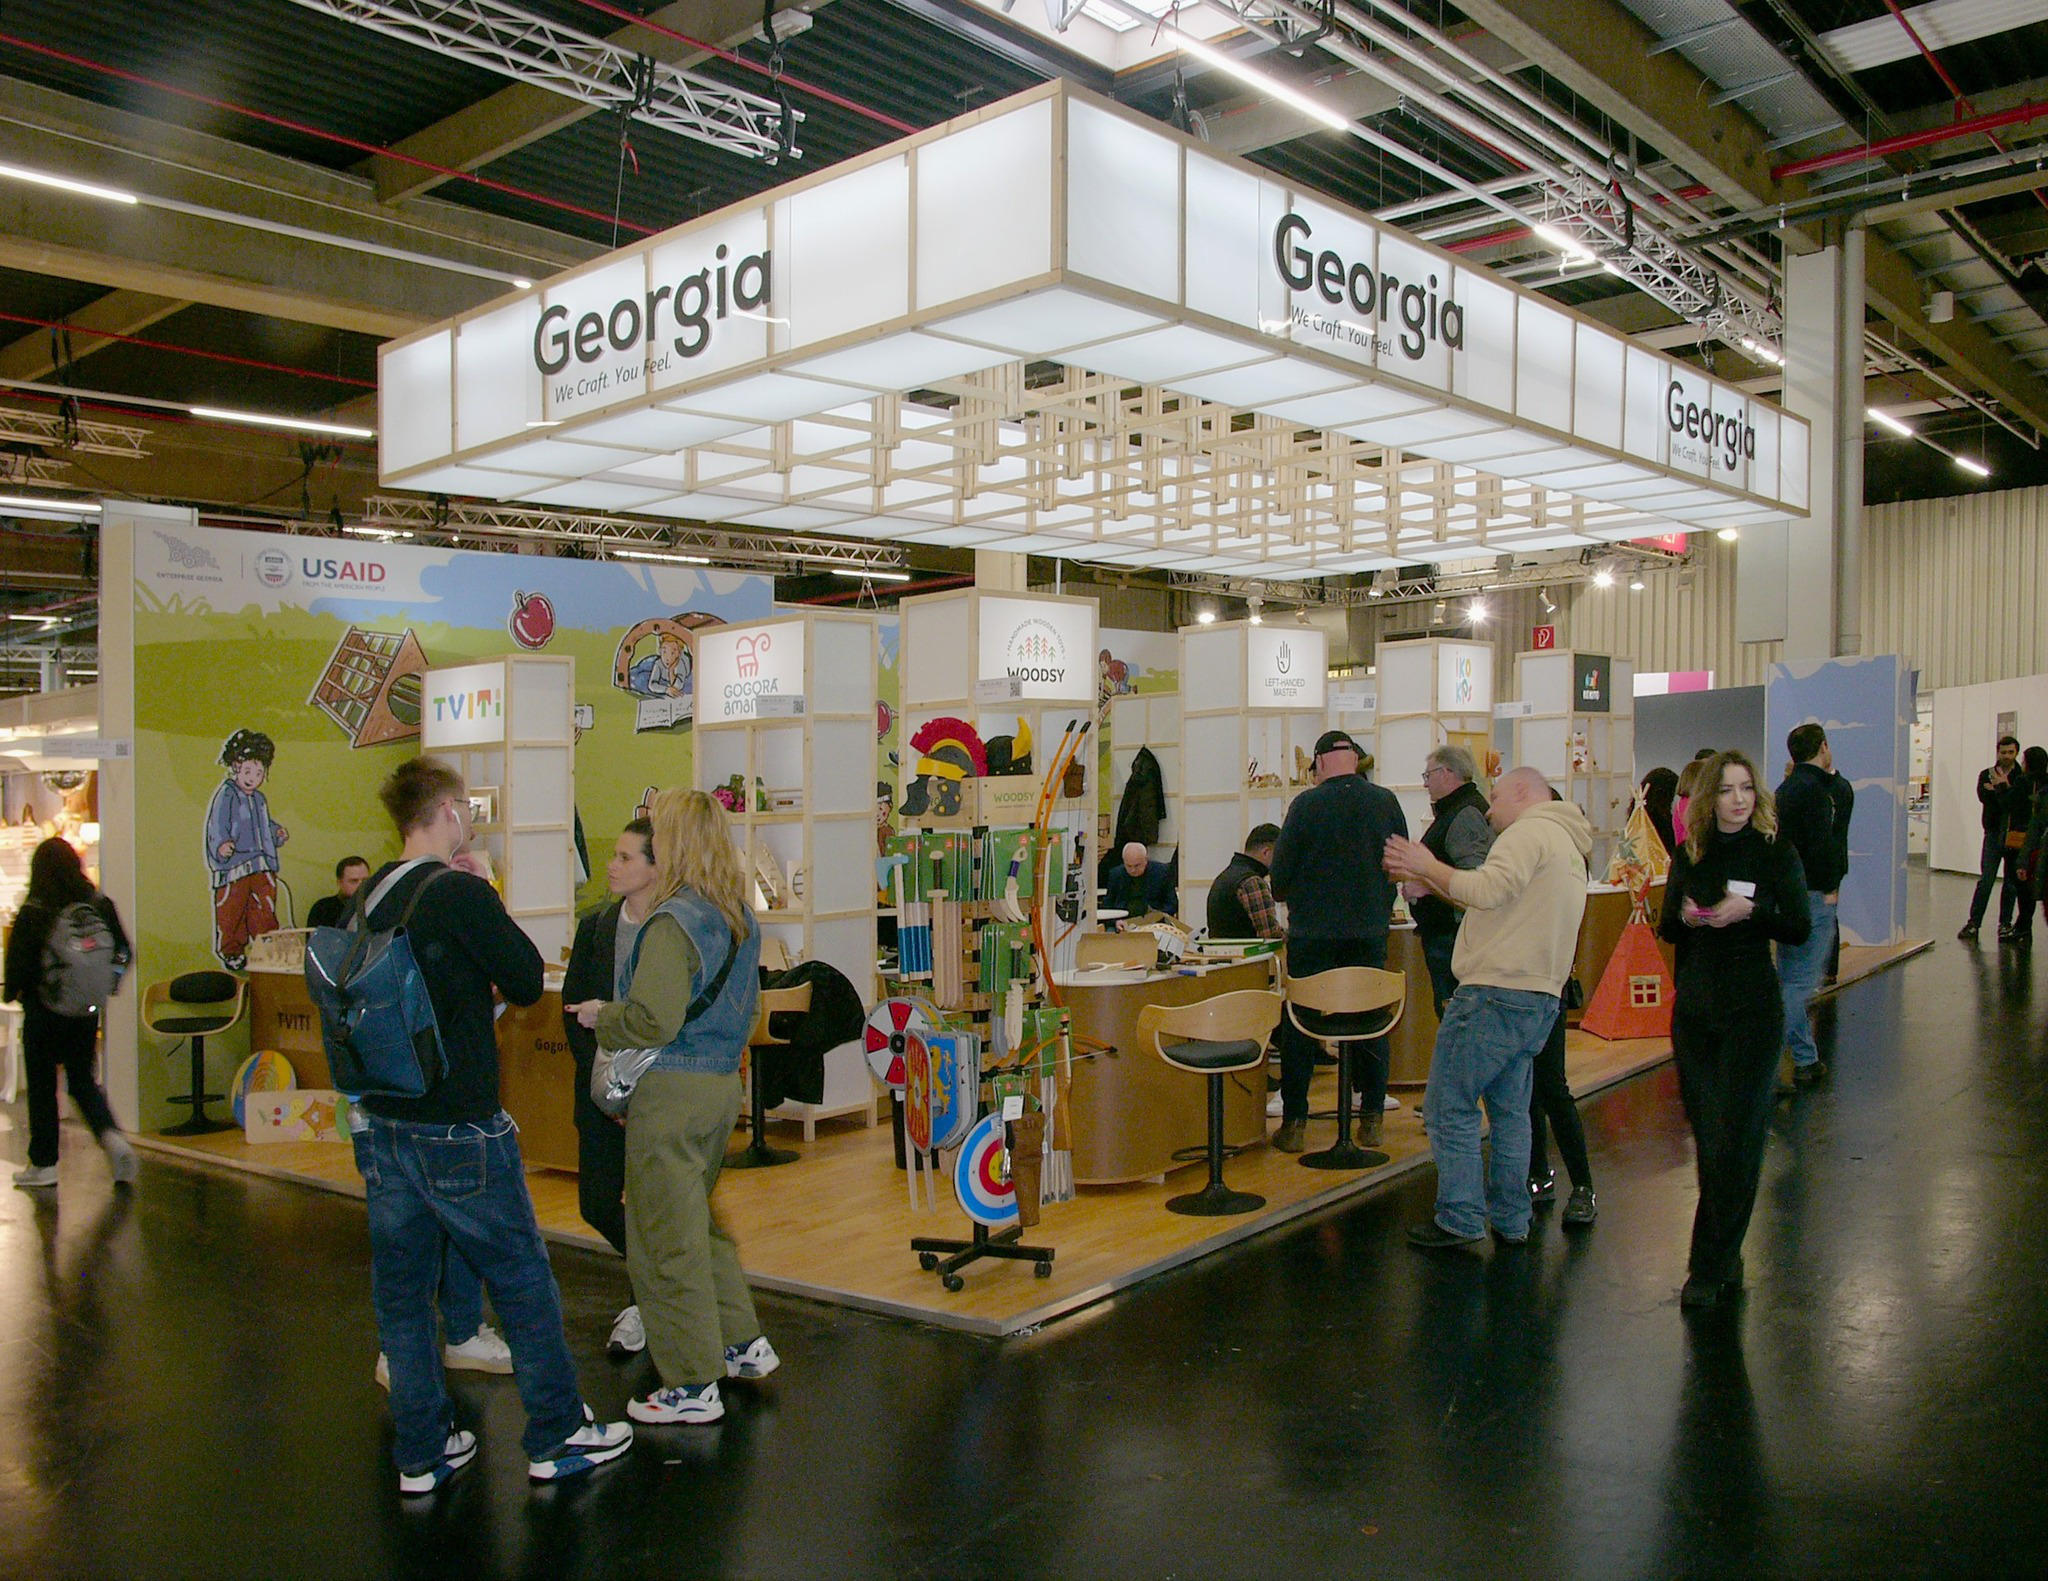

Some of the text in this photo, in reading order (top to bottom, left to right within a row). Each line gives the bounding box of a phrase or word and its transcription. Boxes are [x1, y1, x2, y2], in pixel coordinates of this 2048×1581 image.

[1275, 213, 1464, 360] Georgia
[533, 243, 771, 376] Georgia
[1291, 305, 1394, 357] We Craft. You Feel.
[555, 352, 672, 404] We Craft. You Feel.
[1667, 380, 1755, 471] Georgia
[302, 557, 386, 583] USAID
[1007, 667, 1065, 683] WOODSY
[1264, 678, 1306, 688] LEFT-HANDED
[1273, 688, 1298, 697] MASTER
[993, 792, 1035, 803] WOODSY
